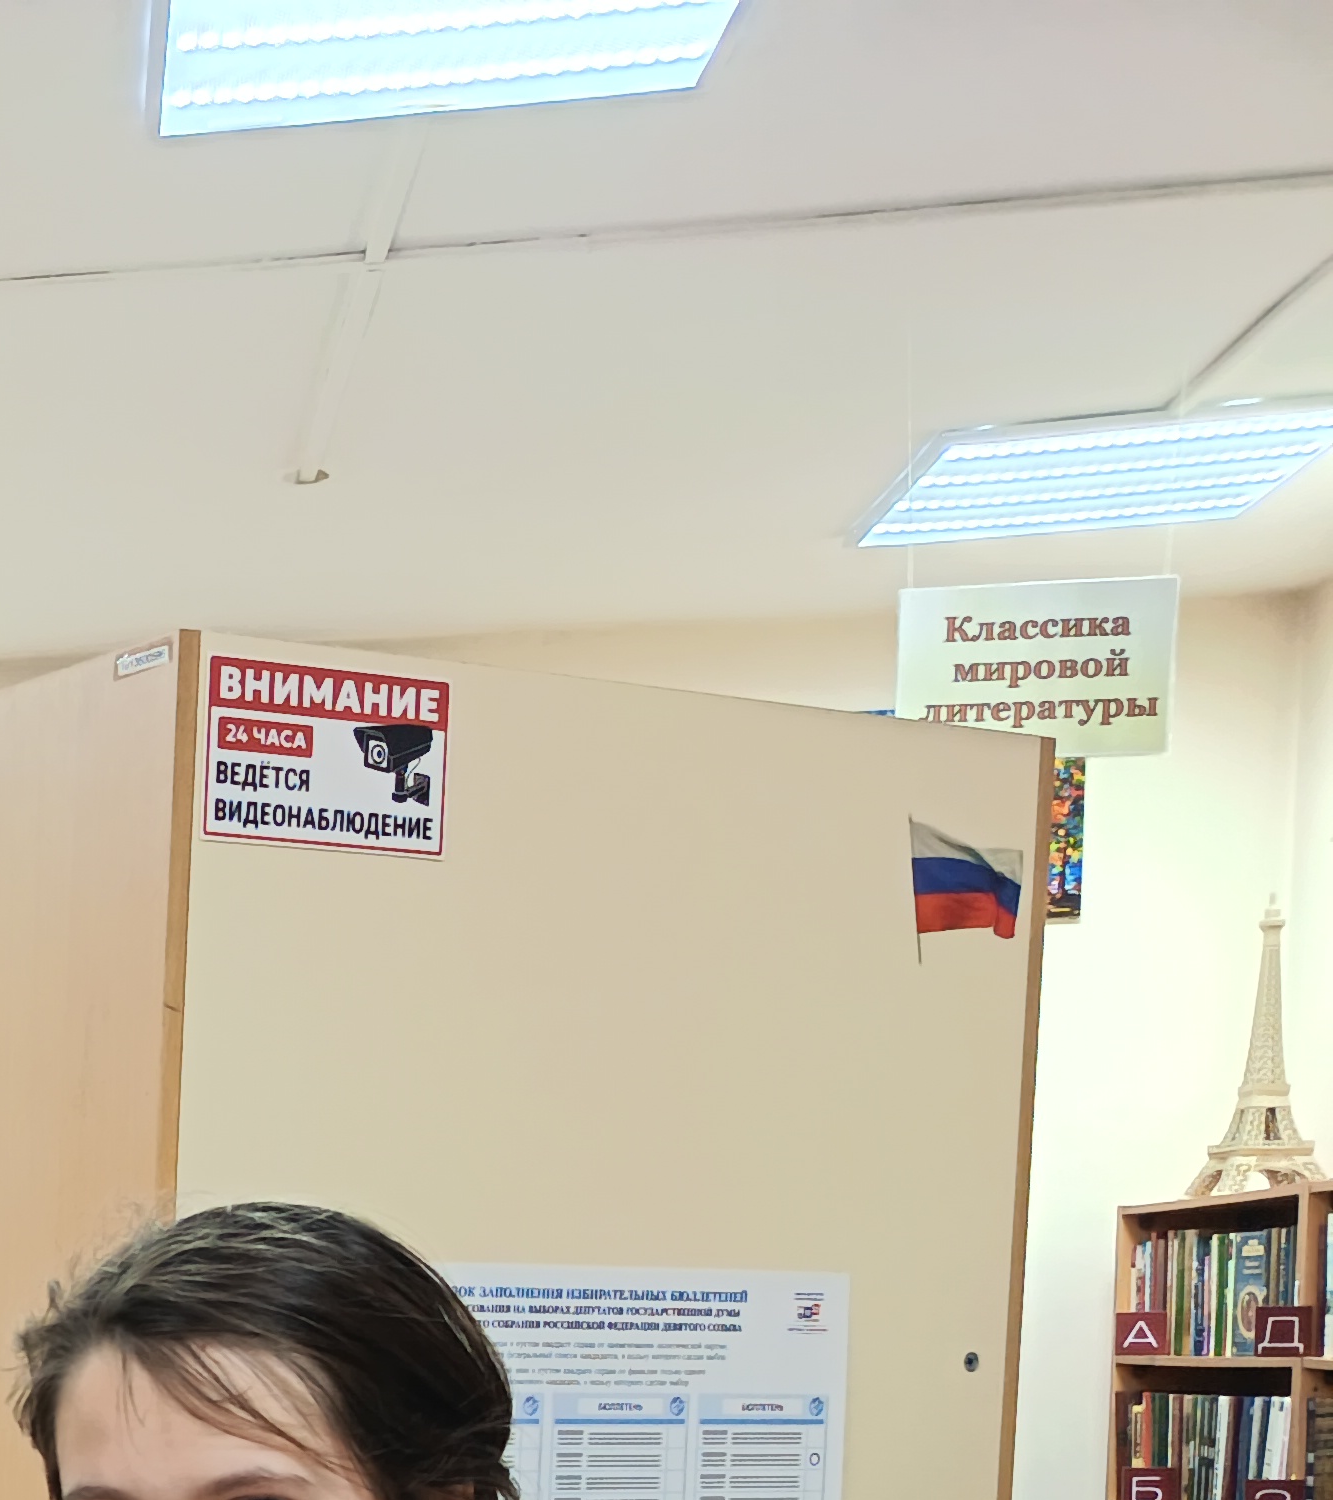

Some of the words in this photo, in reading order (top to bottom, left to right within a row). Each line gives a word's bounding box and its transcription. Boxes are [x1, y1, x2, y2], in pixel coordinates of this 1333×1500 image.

[942, 615, 1131, 643] Классика
[952, 648, 1131, 688] мировой
[219, 665, 440, 723] ВНИМАНИЕ
[919, 696, 1159, 728] литературы
[225, 723, 249, 743] 24
[252, 726, 307, 750] ЧАСА
[215, 760, 310, 792] ВЕДЁТСЯ
[214, 798, 434, 840] ВИДЕОНАБЛЮДЕНИЕ
[479, 1286, 564, 1300] ЗАПОЛНЕНИЯ
[566, 1287, 667, 1301] ИЗБИРАТЕЛЬНЫХ
[1122, 1320, 1159, 1349] А
[1257, 1316, 1304, 1355] Д
